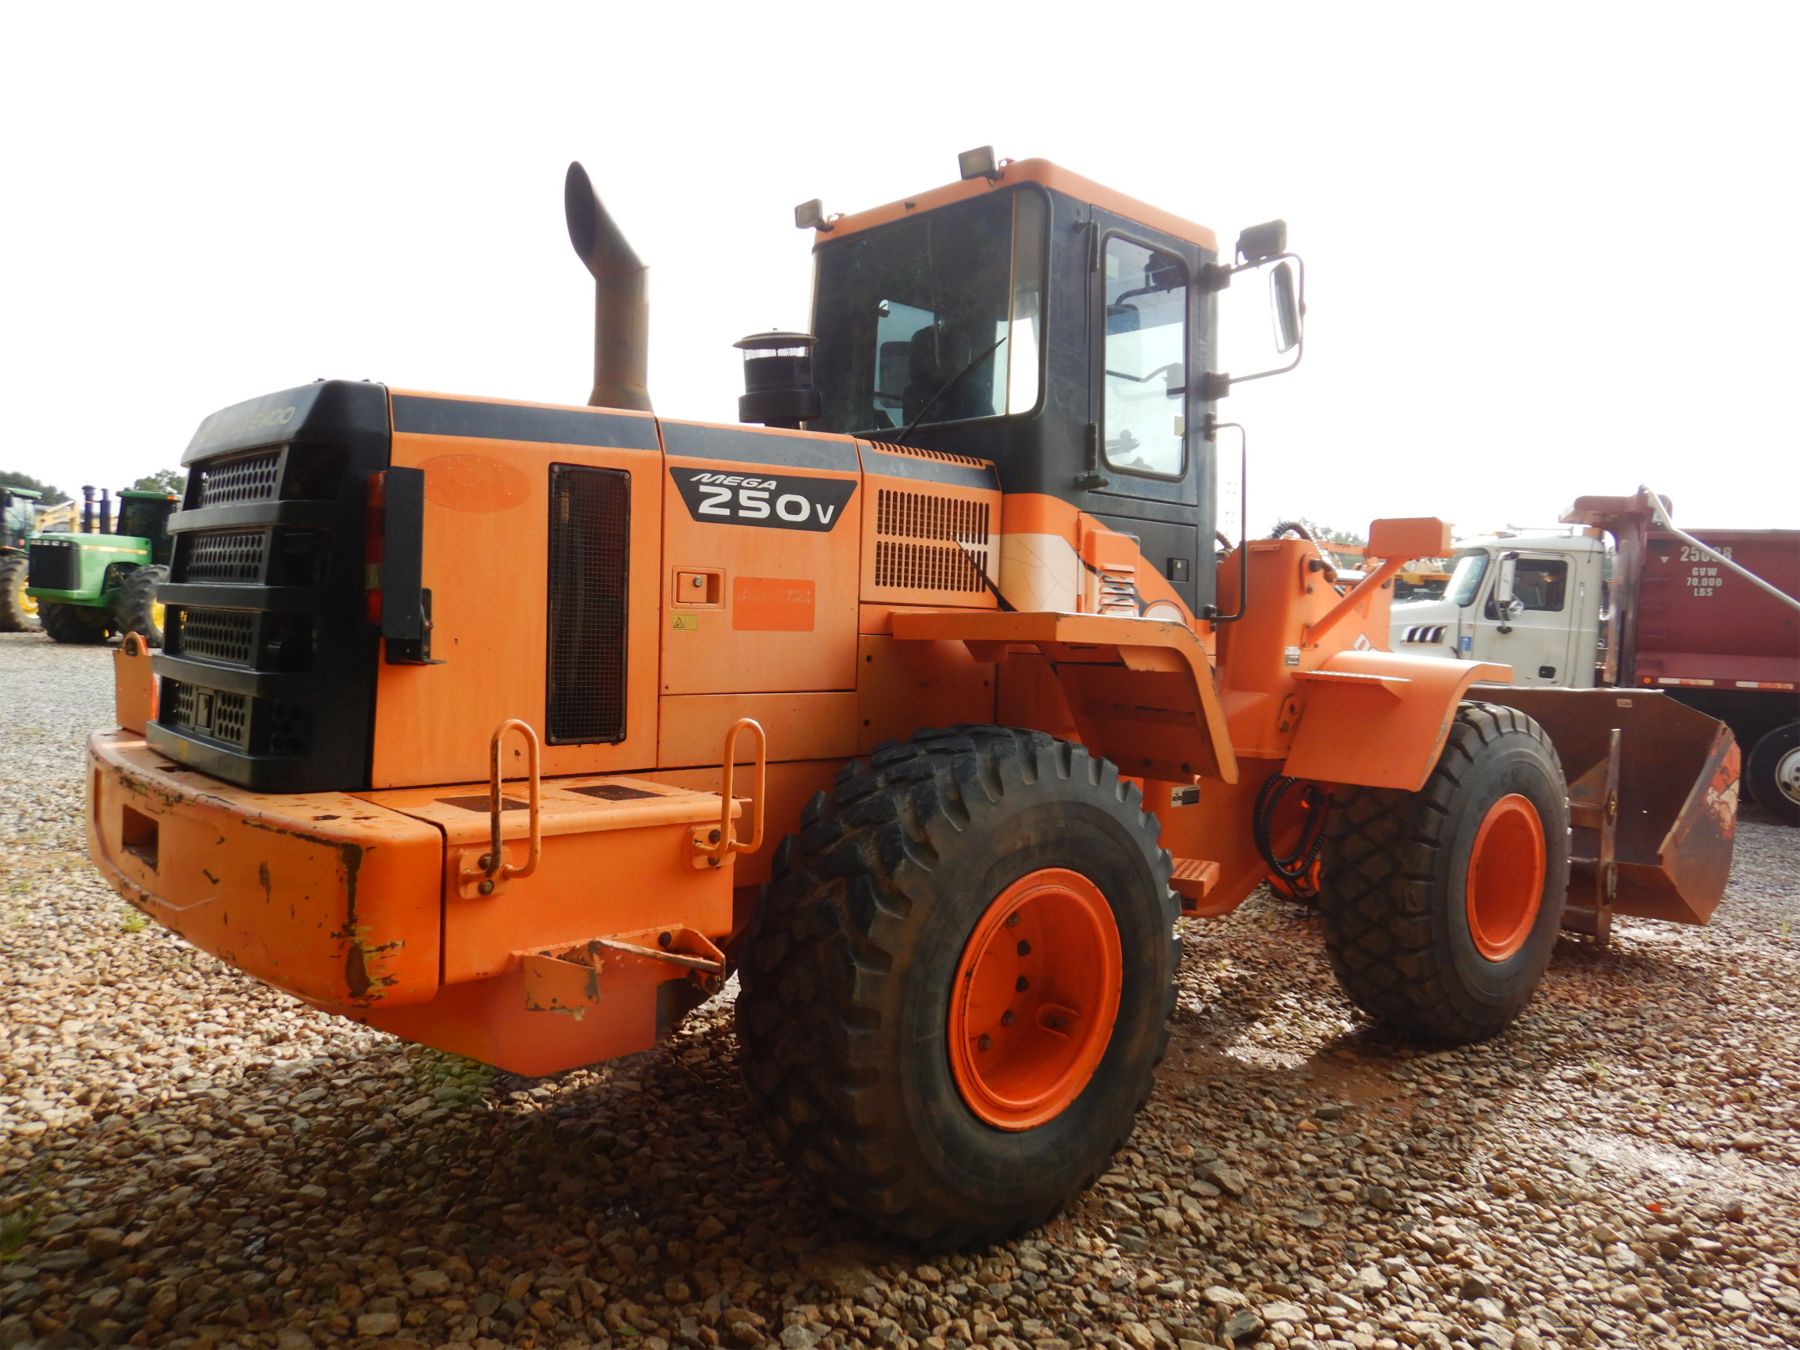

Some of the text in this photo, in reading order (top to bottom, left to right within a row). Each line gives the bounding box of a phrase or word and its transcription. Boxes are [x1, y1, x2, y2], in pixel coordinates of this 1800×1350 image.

[689, 472, 778, 491] MEGA
[1691, 566, 1718, 577] GVW
[1693, 587, 1713, 597] LBS
